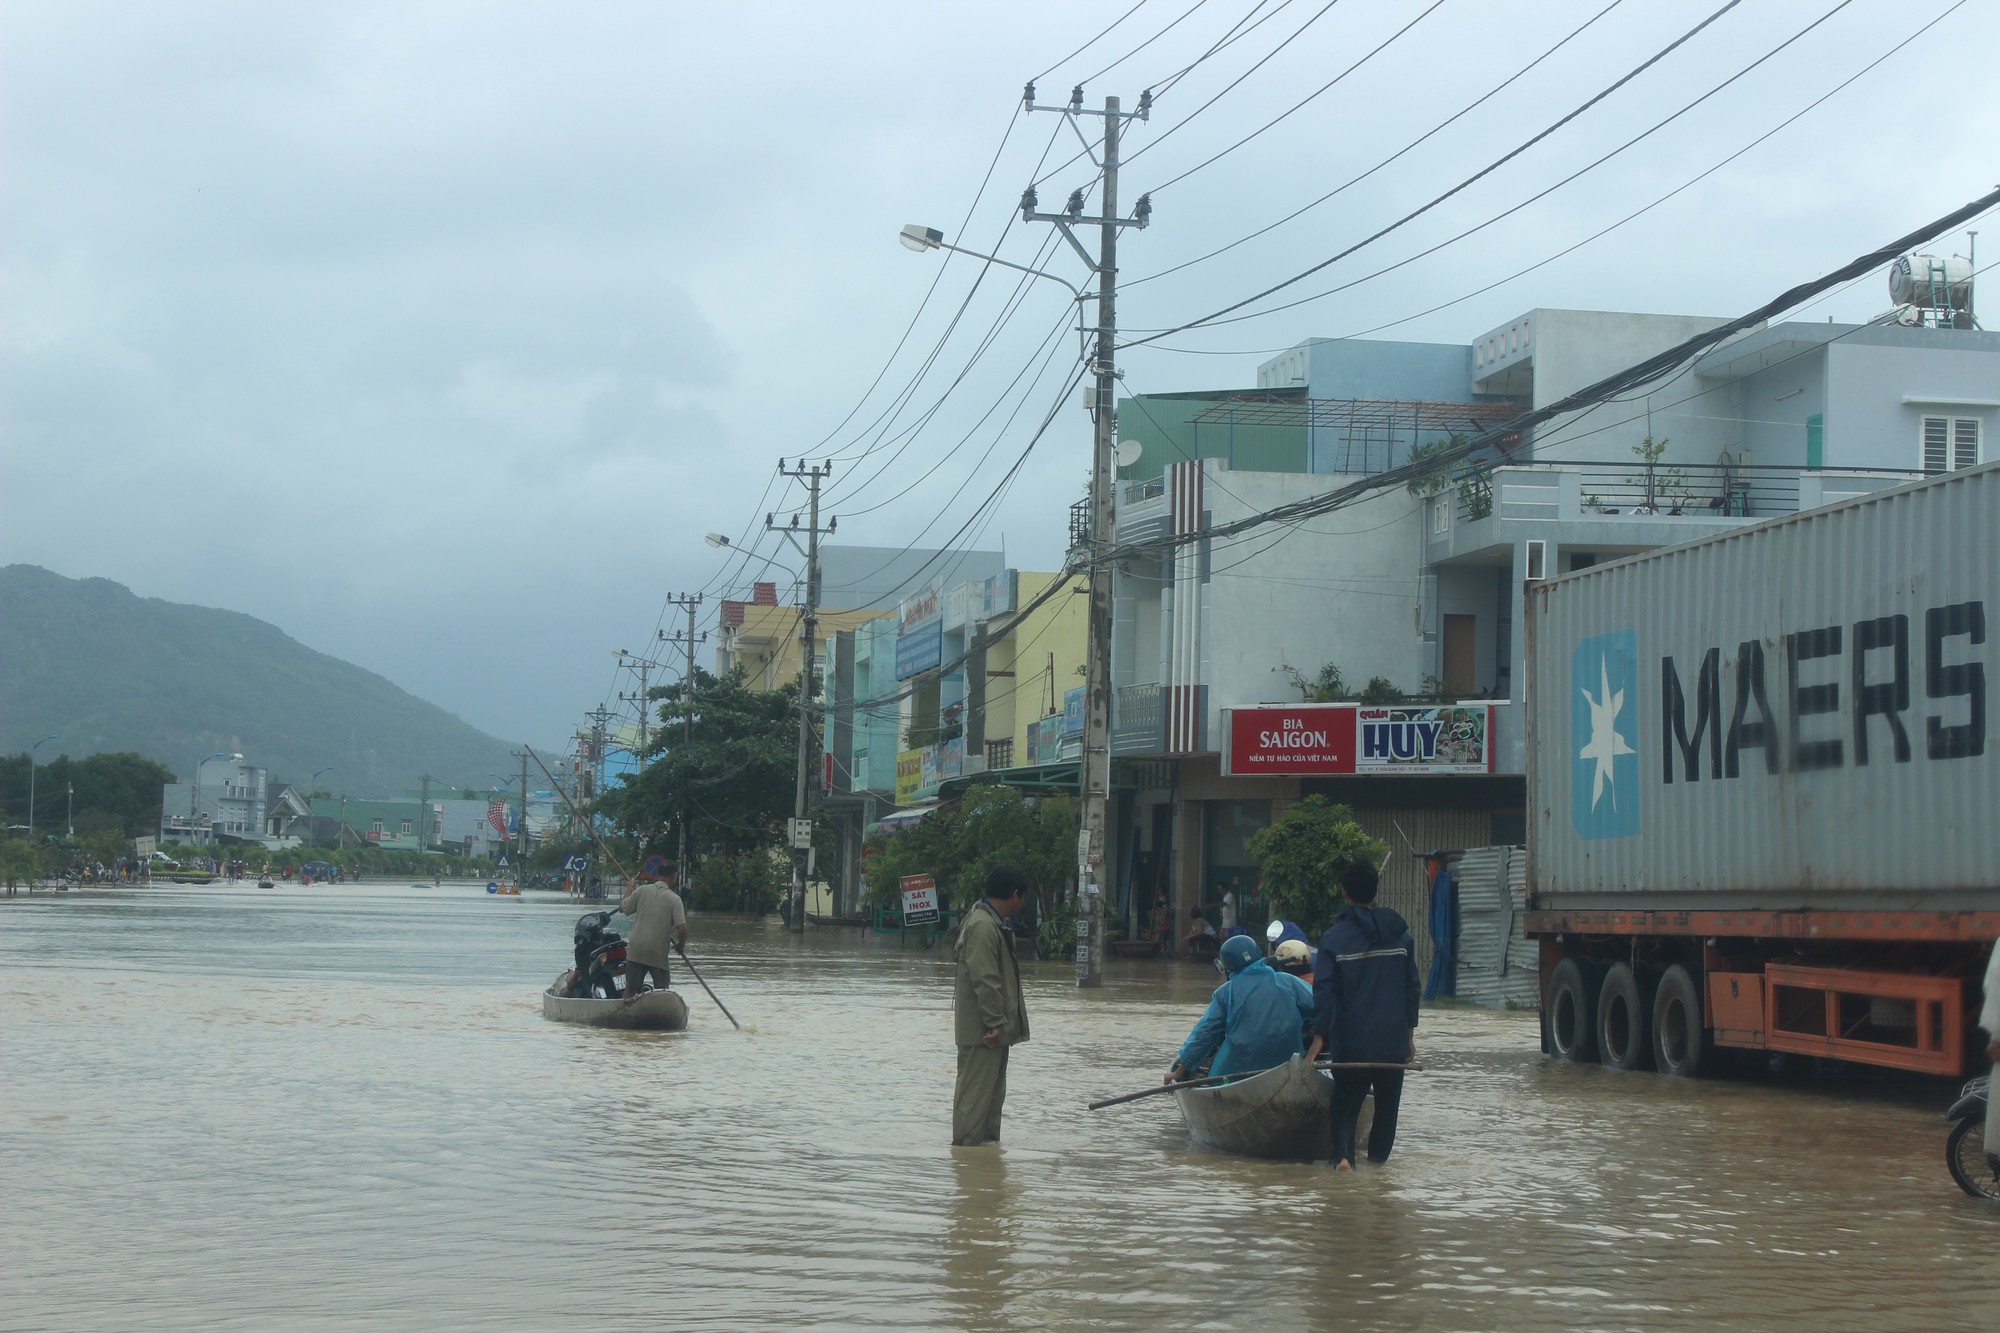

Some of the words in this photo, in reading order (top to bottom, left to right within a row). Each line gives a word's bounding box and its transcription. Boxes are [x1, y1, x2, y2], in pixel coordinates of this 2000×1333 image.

[1662, 601, 1986, 784] MAERS
[1359, 708, 1389, 720] QUÁN
[1283, 719, 1304, 730] BIA
[1259, 731, 1327, 748] SAIGON
[1362, 721, 1443, 759] HUY
[1292, 753, 1306, 762] CỦA
[1307, 754, 1321, 763] VIỆT
[909, 901, 931, 910] INOX
